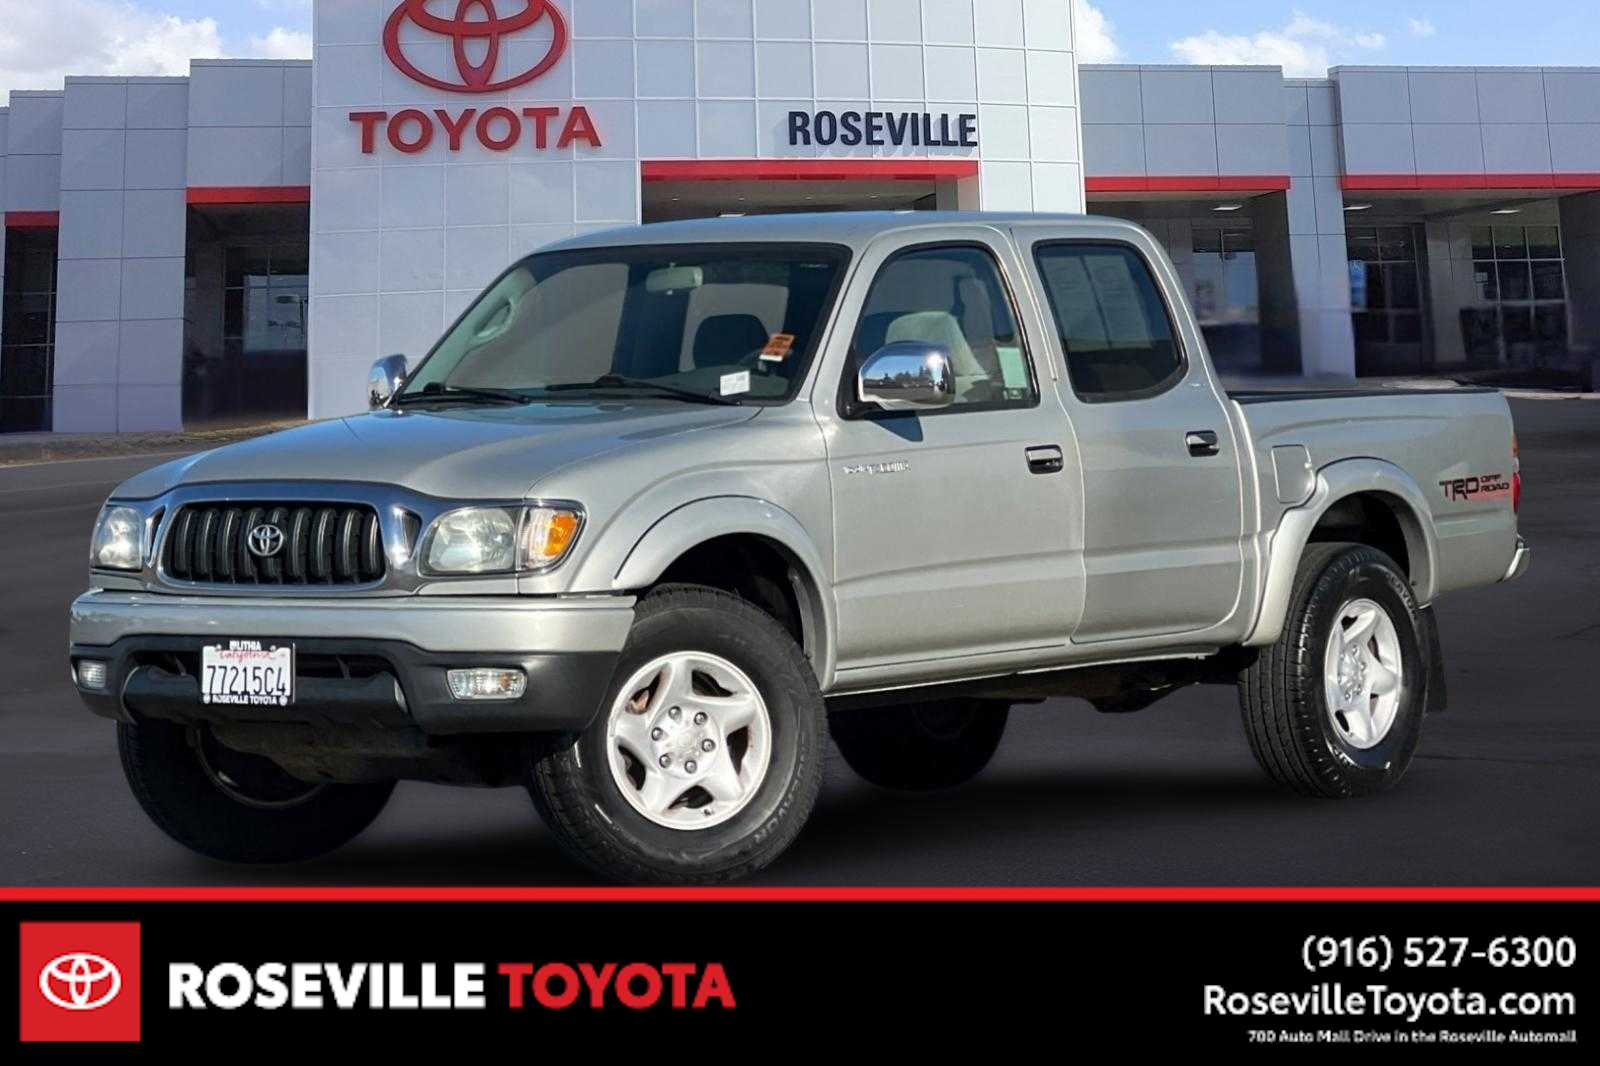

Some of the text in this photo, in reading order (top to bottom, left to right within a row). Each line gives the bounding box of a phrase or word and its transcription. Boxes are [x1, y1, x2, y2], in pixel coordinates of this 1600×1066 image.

[349, 106, 602, 154] TOYOTA
[788, 110, 979, 147] ROSEVILLE
[1439, 476, 1480, 501] TRD
[1480, 474, 1501, 483] OFF
[1480, 482, 1510, 493] ROAD
[206, 665, 287, 694] 77215C4
[212, 693, 277, 705] ROSEVILLE TOYOTA
